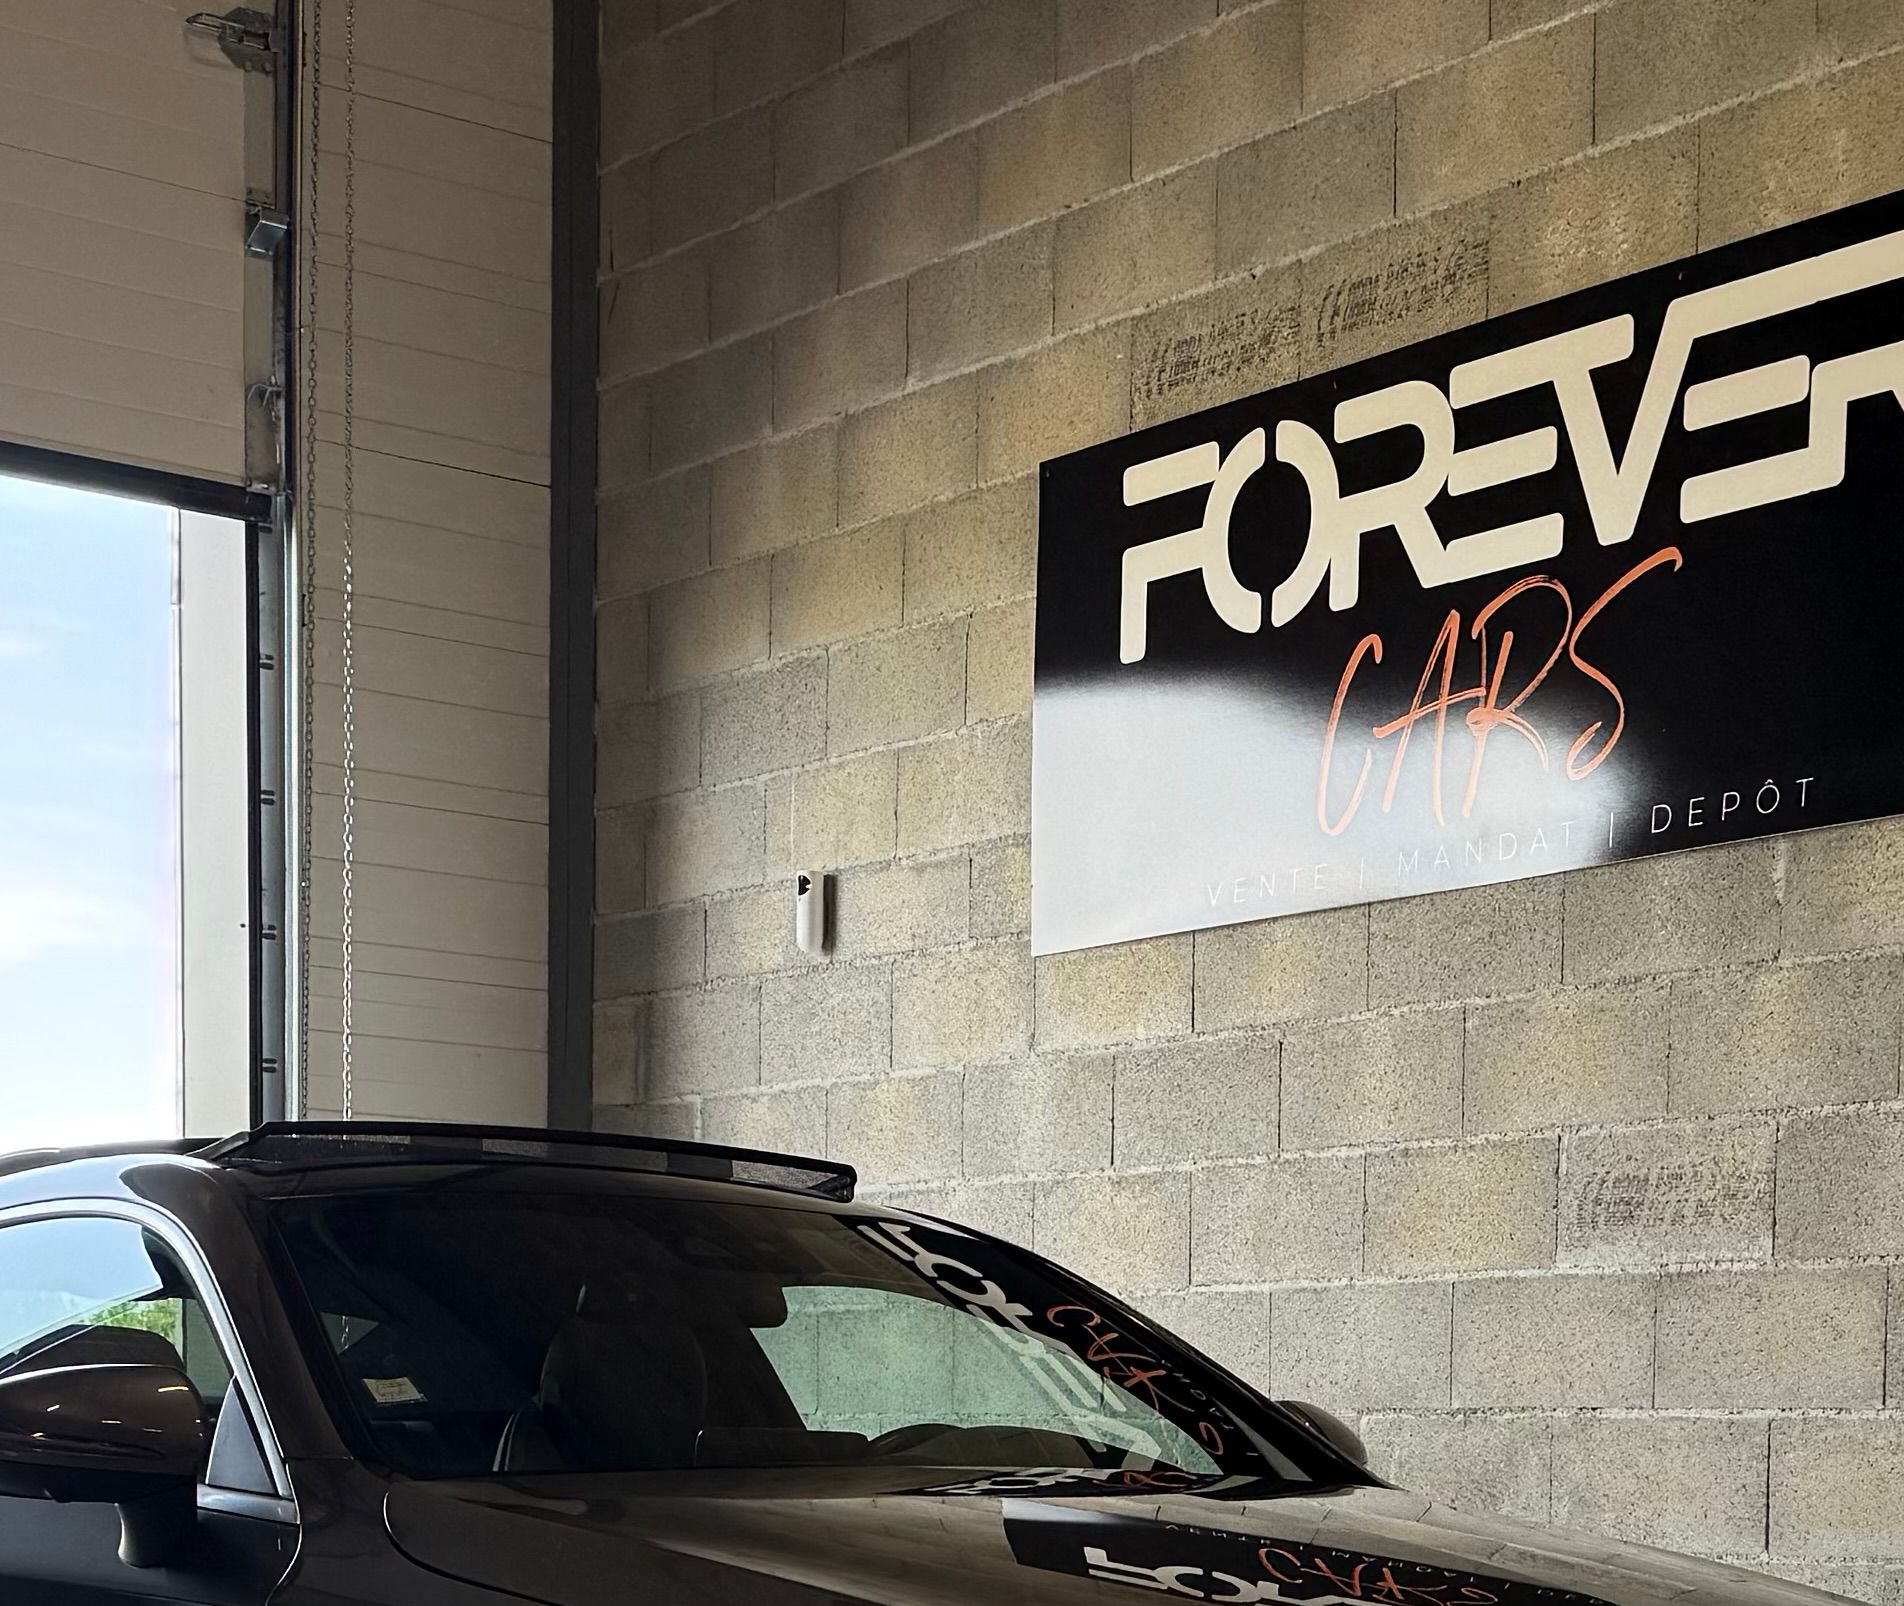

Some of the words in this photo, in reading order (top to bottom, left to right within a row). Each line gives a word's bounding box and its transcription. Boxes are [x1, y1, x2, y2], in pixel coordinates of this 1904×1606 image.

[1316, 546, 1683, 836] CARS
[1206, 863, 1329, 908] VENTE
[1397, 820, 1578, 878] MANDAT
[1650, 777, 1815, 834] DEPÔT
